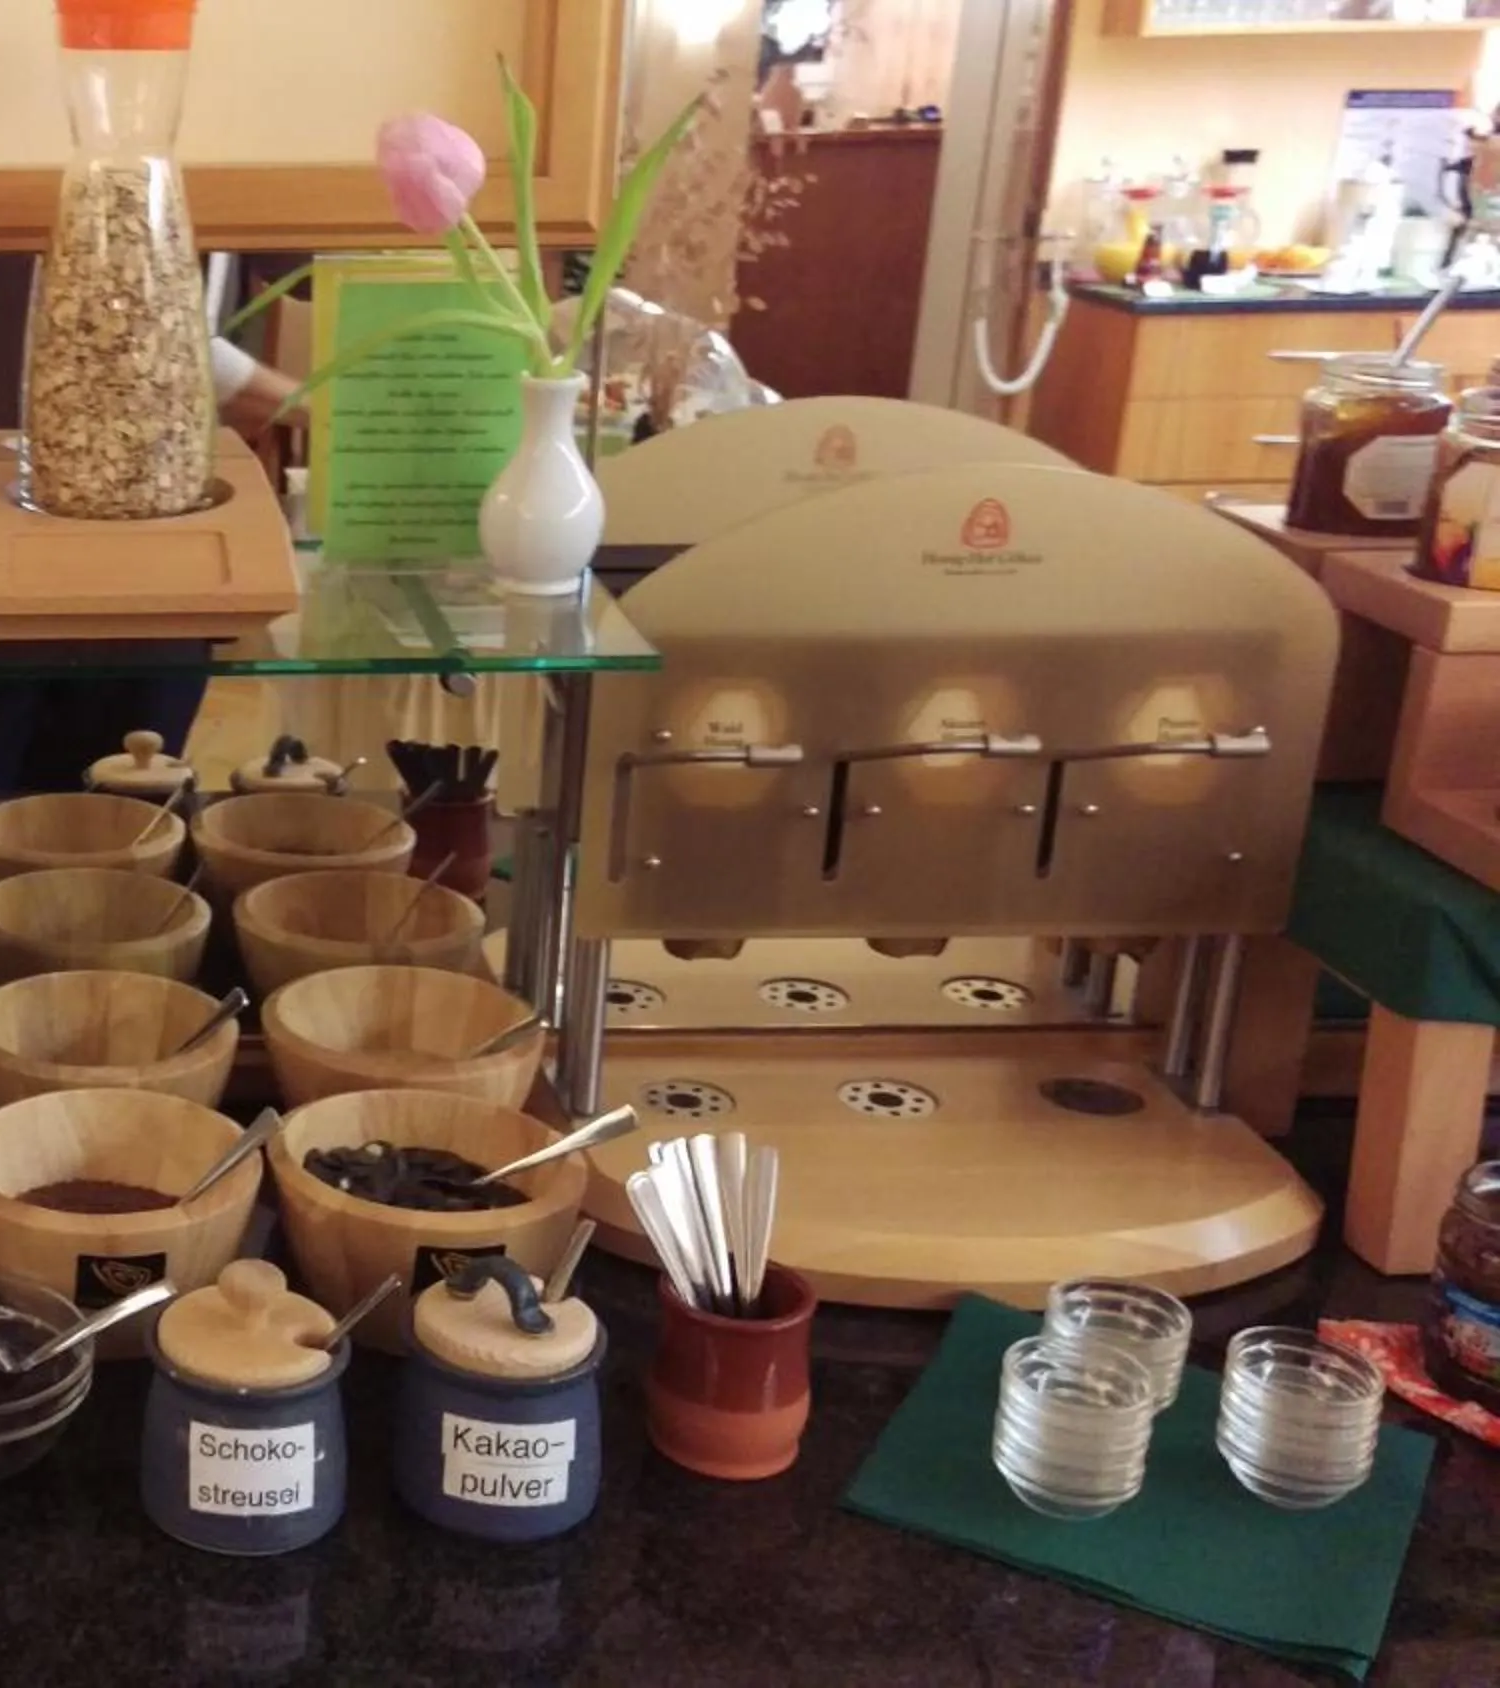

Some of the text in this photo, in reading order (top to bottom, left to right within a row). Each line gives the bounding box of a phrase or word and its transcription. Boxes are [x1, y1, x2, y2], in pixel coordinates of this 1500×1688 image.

[199, 1433, 306, 1462] Schoko-
[453, 1423, 565, 1459] Kakao-
[197, 1480, 300, 1507] streusel
[460, 1472, 555, 1500] pulver
